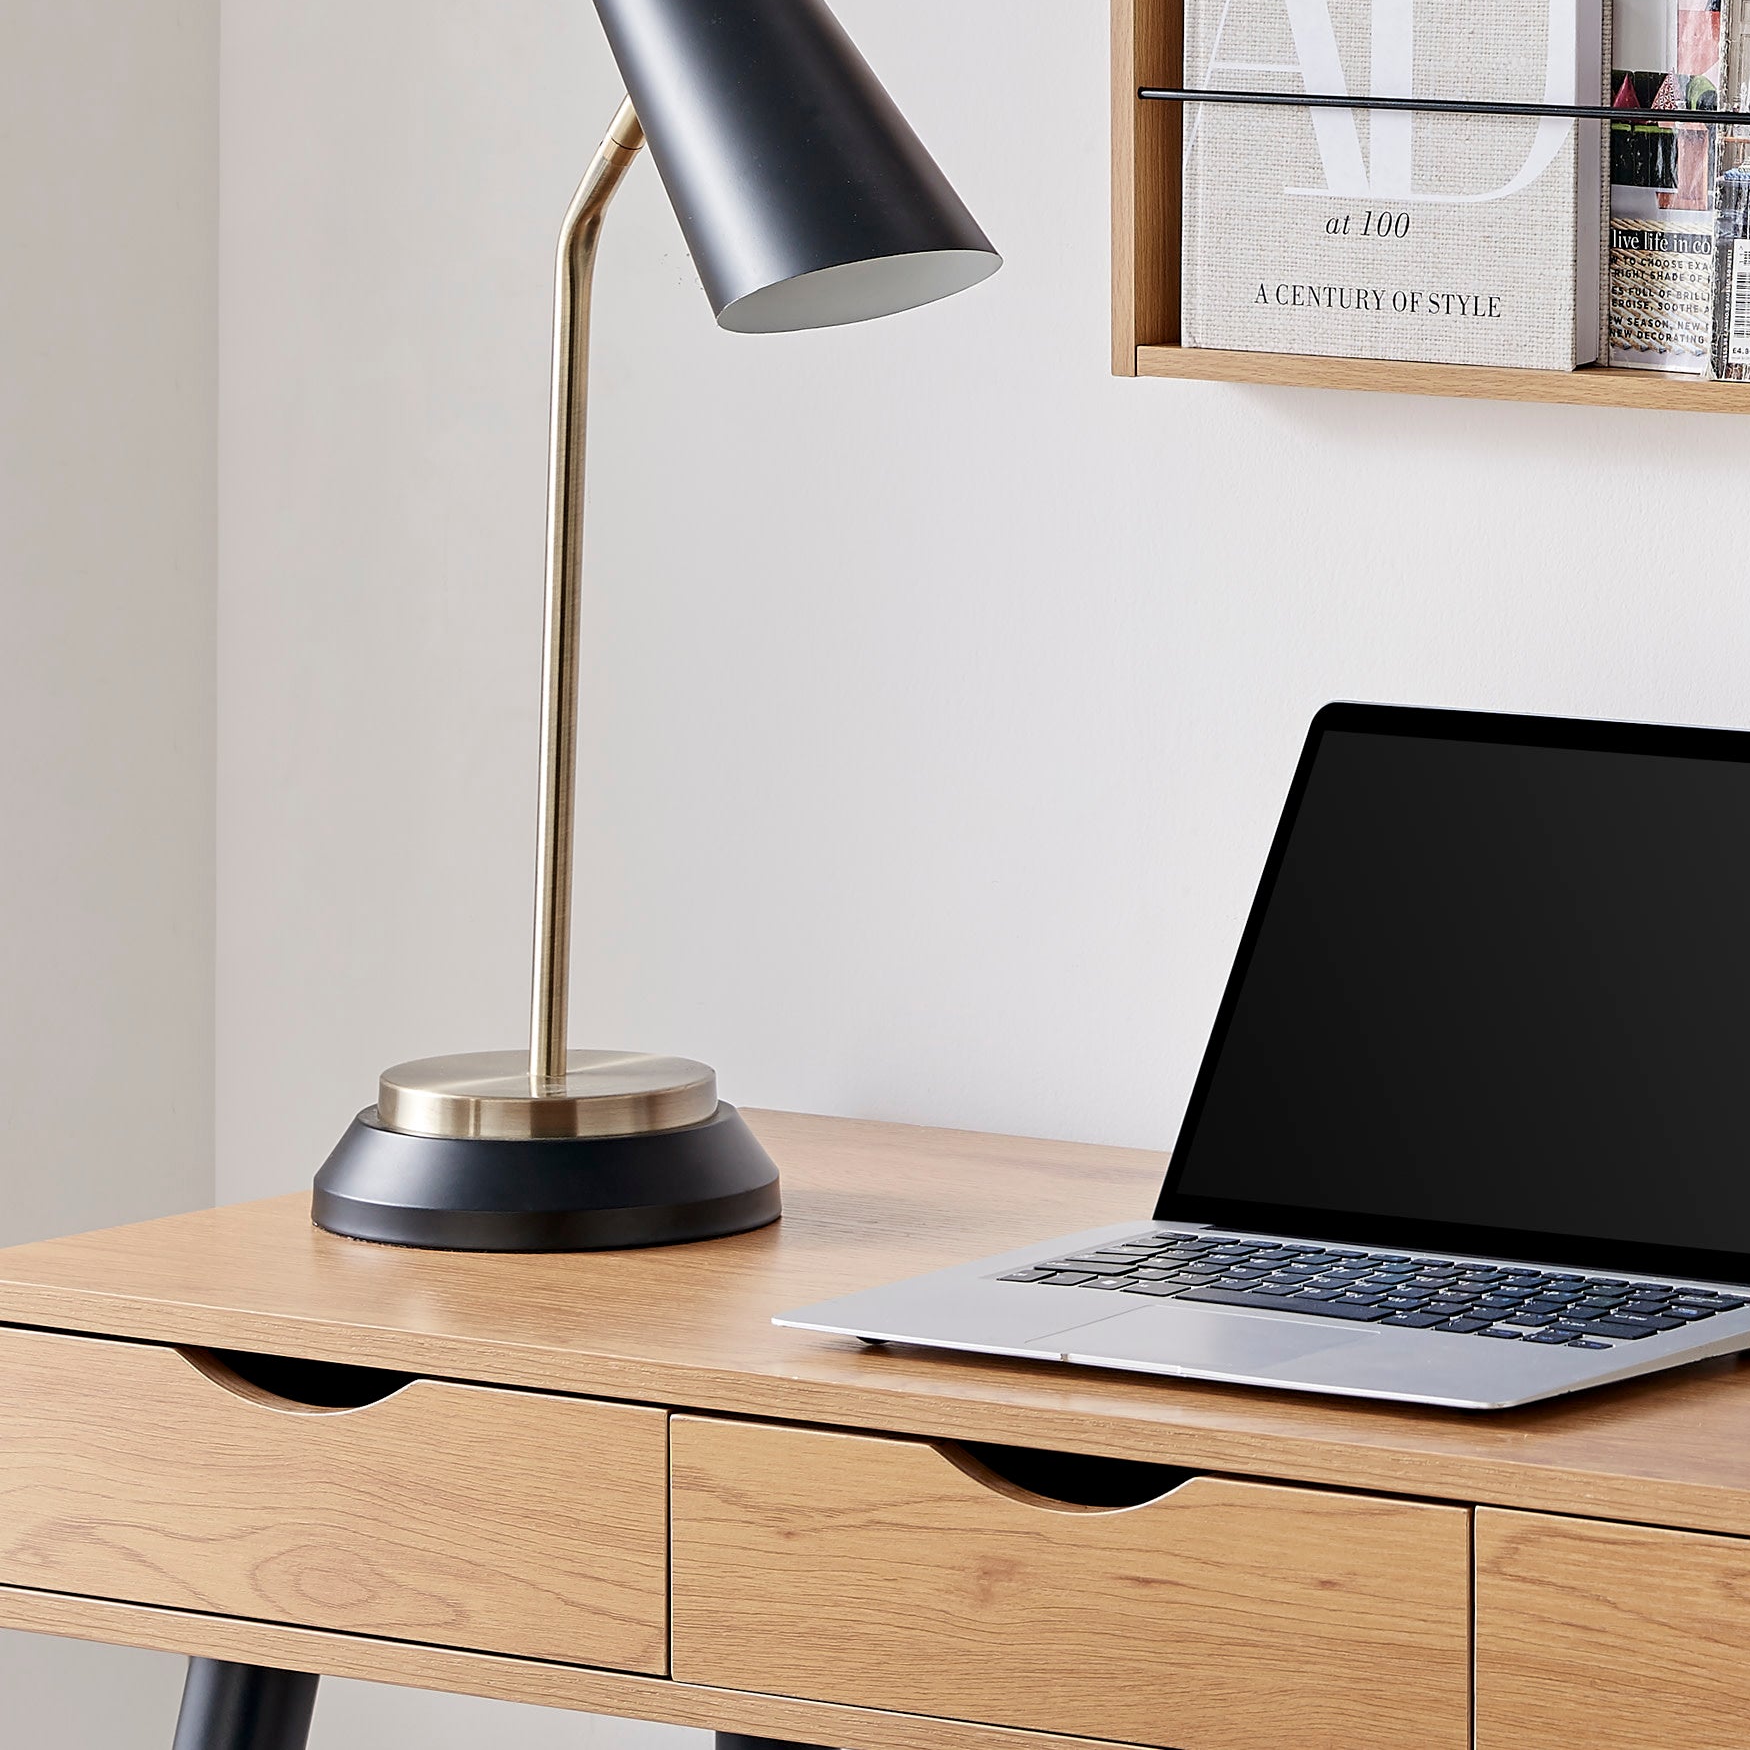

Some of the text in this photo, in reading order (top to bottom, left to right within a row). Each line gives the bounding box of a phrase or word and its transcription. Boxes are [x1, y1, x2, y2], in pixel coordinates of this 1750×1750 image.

[1325, 210, 1410, 239] at 100
[1613, 229, 1640, 250] live
[1644, 231, 1669, 252] life
[1673, 234, 1688, 253] in
[1622, 256, 1636, 266] TO
[1640, 258, 1683, 269] CHOOSE
[1688, 261, 1712, 271] EXA
[1650, 271, 1684, 282] SHADE
[1689, 274, 1703, 283] OF
[1628, 287, 1654, 298] FULL
[1659, 289, 1673, 299] OF
[1254, 283, 1502, 319] A CENTURY OF STYLE
[1658, 302, 1699, 314] SOOTHE
[1626, 317, 1673, 330] SEASON,
[1677, 321, 1701, 330] NEW
[1636, 331, 1705, 344] DECORATING
